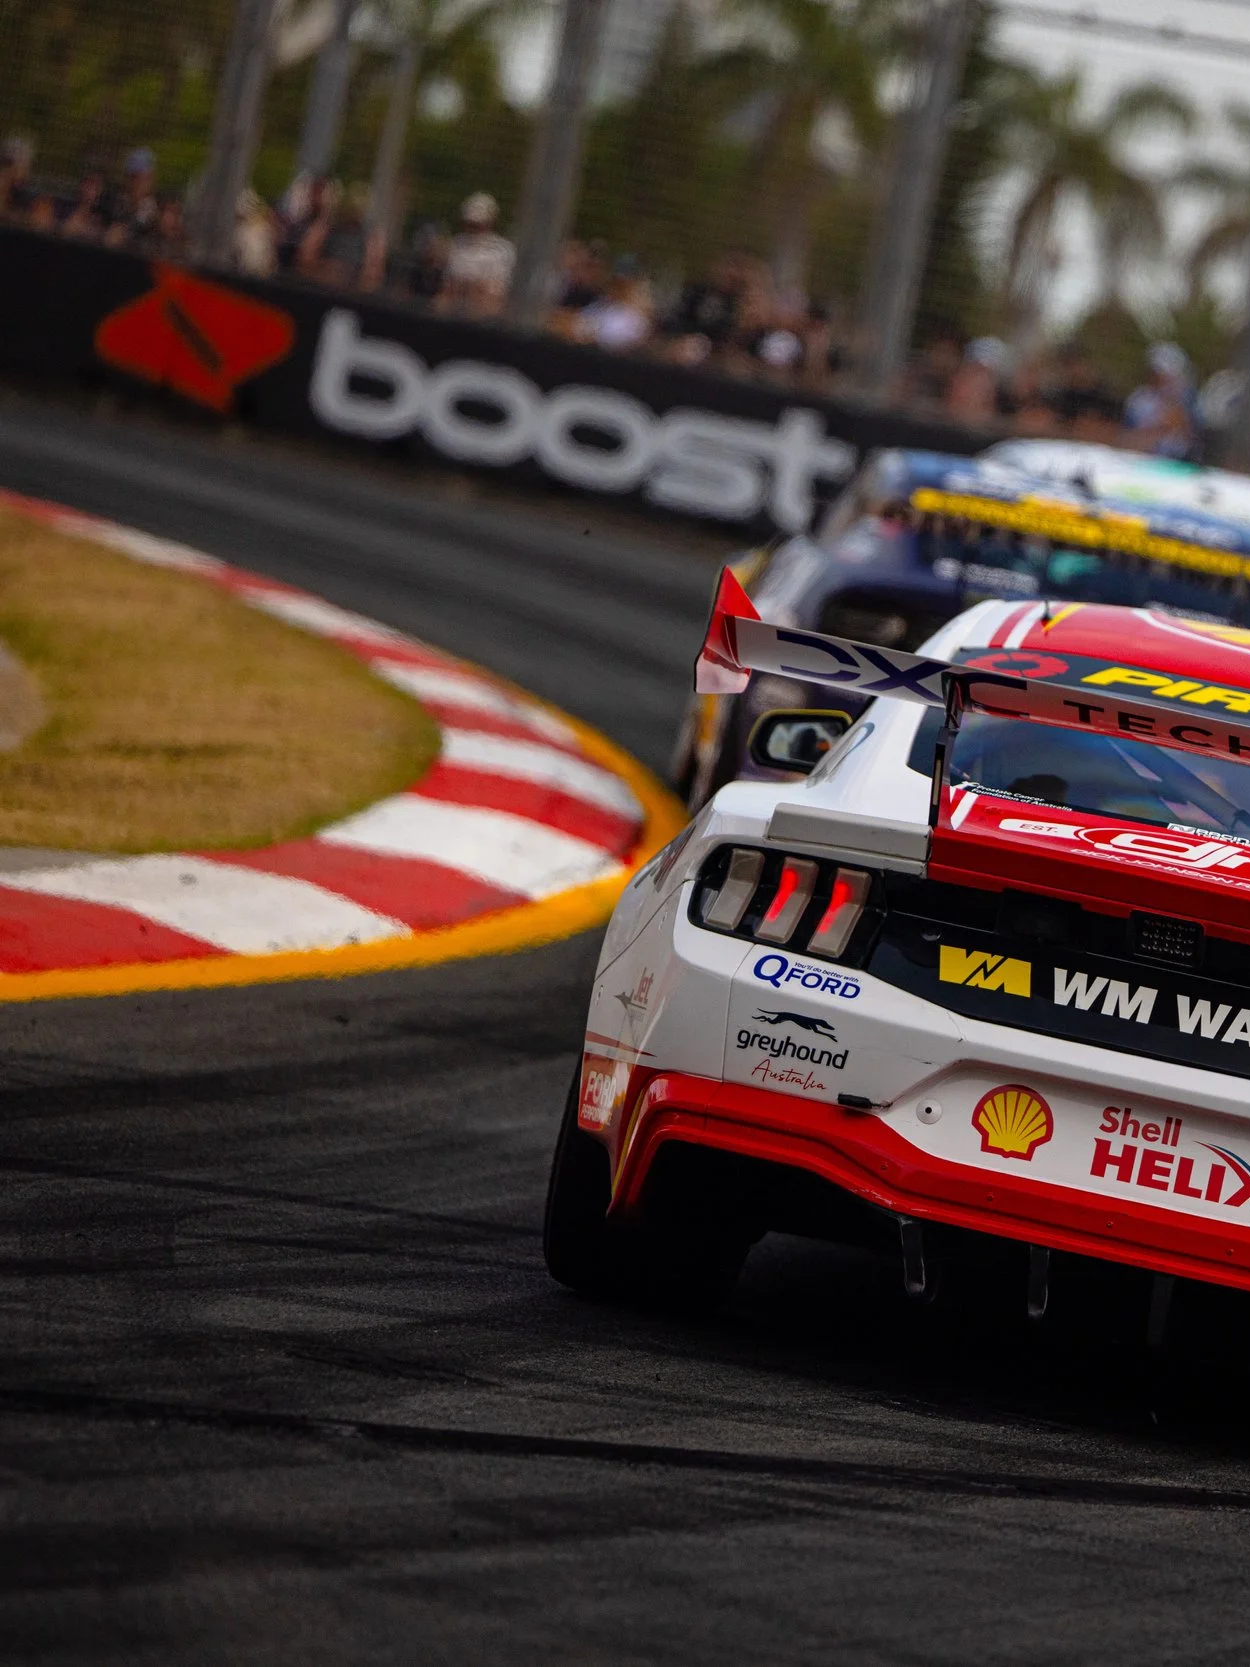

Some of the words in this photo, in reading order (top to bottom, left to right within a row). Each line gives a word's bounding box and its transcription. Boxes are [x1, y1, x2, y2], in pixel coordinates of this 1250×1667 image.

[309, 308, 854, 533] boost
[971, 788, 1018, 802] Foundation
[1031, 801, 1073, 812] Australia
[977, 784, 1012, 796] Prostate
[1013, 792, 1045, 802] Cancer
[1020, 823, 1058, 833] EST.
[1070, 848, 1126, 861] DICK
[1126, 859, 1234, 884] JOHNSON
[822, 969, 843, 979] better
[843, 974, 859, 983] with
[1054, 967, 1158, 1024] WM
[736, 1028, 849, 1070] greyhound
[751, 1058, 828, 1090] Australia
[1099, 1106, 1183, 1148] Shell
